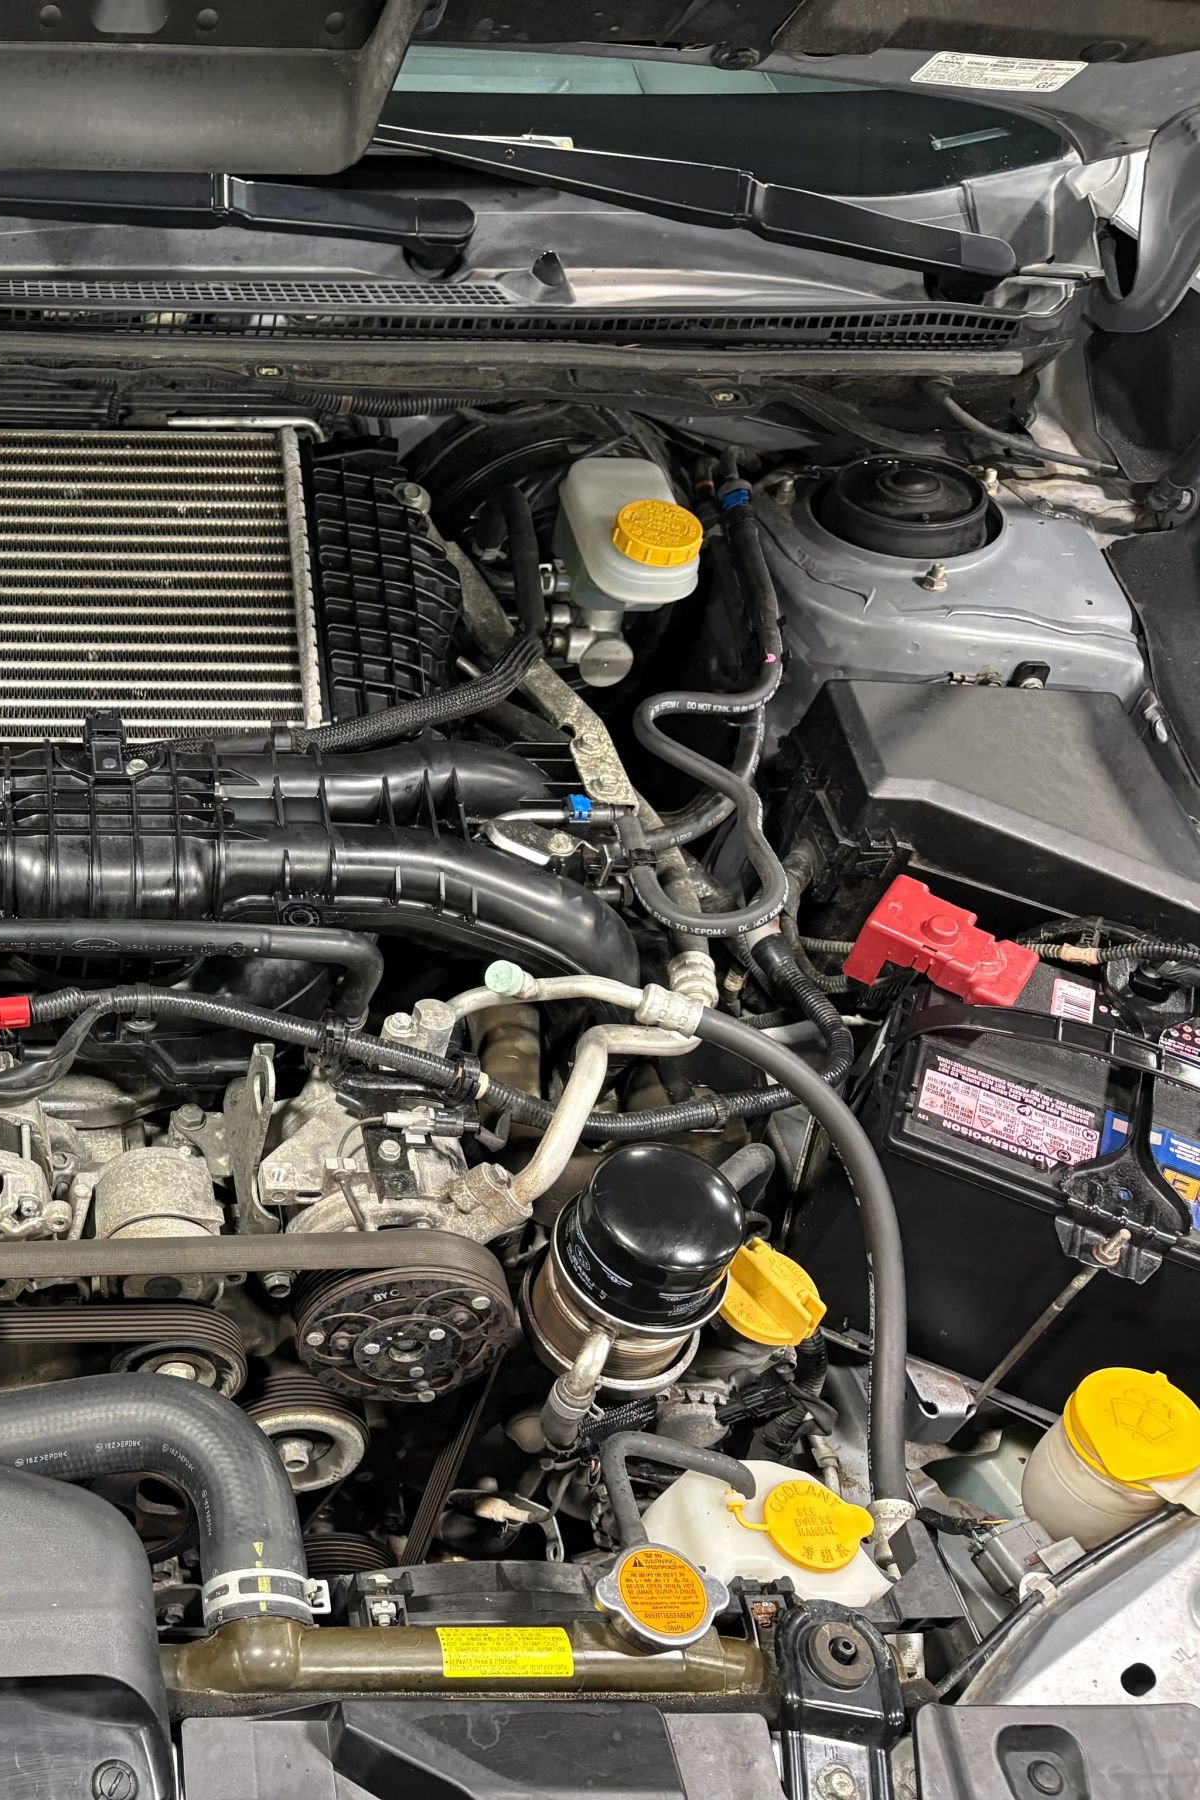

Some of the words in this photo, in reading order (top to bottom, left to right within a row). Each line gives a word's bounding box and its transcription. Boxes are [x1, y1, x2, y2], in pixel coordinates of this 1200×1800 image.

[1036, 81, 1057, 89] GF
[686, 701, 697, 710] DO
[653, 911, 673, 928] FUEL
[916, 1111, 930, 1121] 12V
[941, 1118, 1045, 1163] DANGER/POISON
[769, 1482, 842, 1513] COOLANT
[797, 1525, 838, 1537] MANUAL
